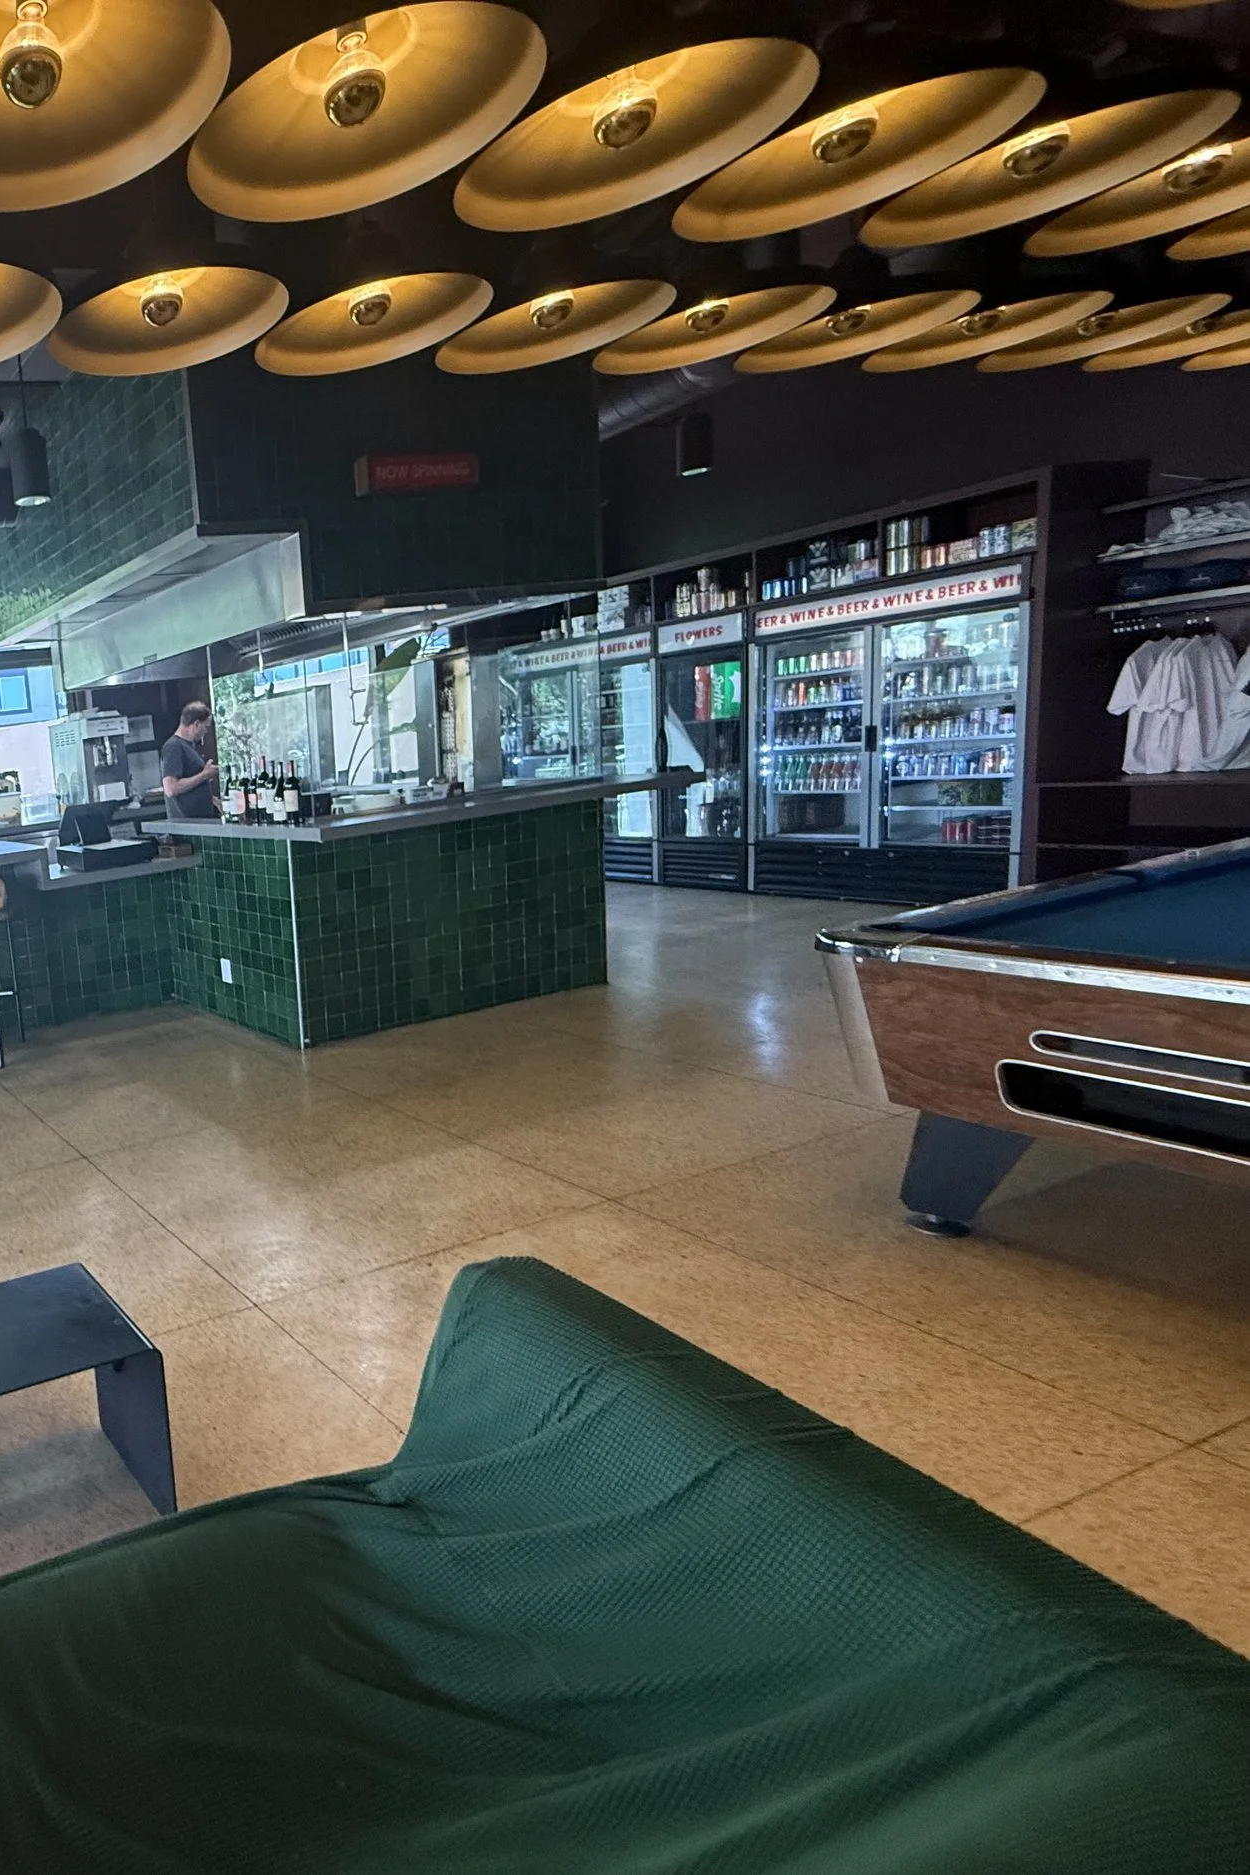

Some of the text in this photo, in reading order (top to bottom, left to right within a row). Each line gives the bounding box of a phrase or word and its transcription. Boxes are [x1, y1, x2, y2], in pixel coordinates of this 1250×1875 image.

[780, 615, 787, 625] &
[791, 606, 825, 623] WINE
[826, 604, 834, 616] &
[837, 599, 870, 616] BEER
[871, 598, 880, 609] &
[883, 590, 923, 608] WINE
[925, 590, 934, 601] &
[938, 580, 975, 599] BEER
[978, 580, 988, 592] &
[674, 625, 724, 643] FLOWERS
[551, 651, 570, 663] BEER
[607, 642, 627, 654] BEER
[713, 675, 724, 711] Sprite
